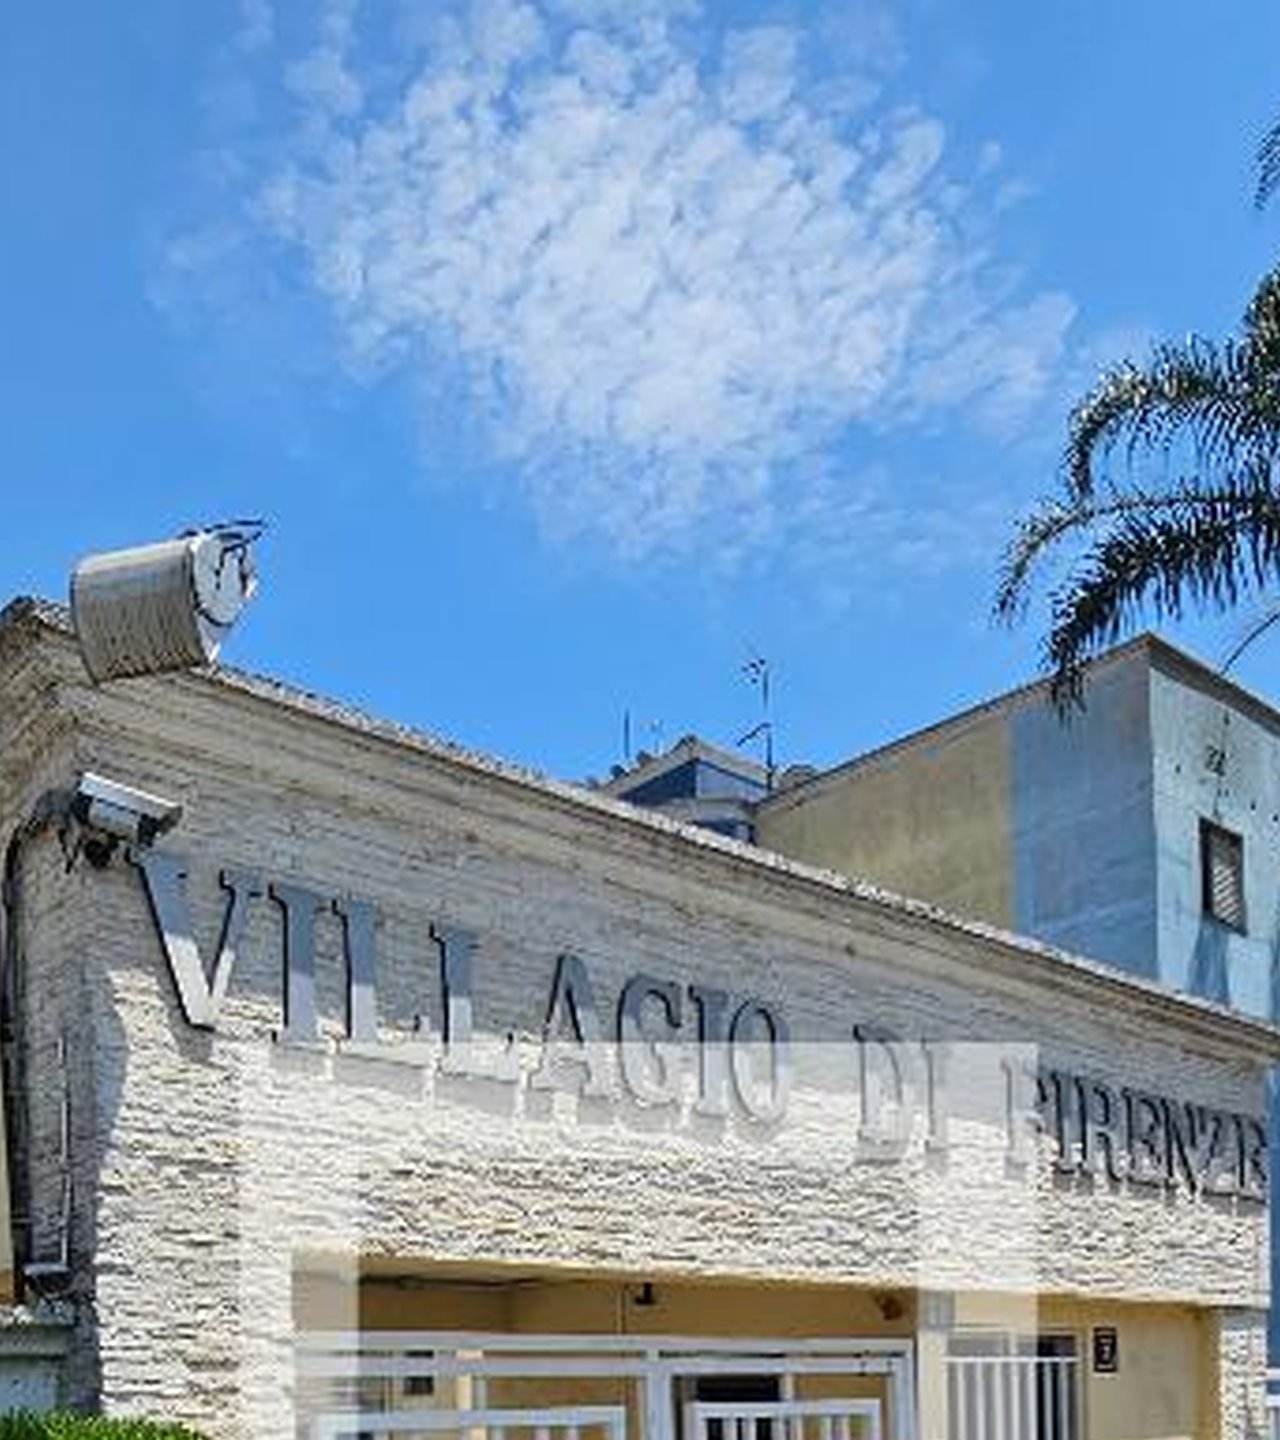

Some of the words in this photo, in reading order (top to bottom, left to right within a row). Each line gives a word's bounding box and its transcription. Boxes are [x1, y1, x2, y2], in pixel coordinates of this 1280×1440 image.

[124, 847, 786, 1126] VILLAGIO
[852, 1022, 948, 1153] DI
[1000, 1054, 1268, 1204] FIRENZE
